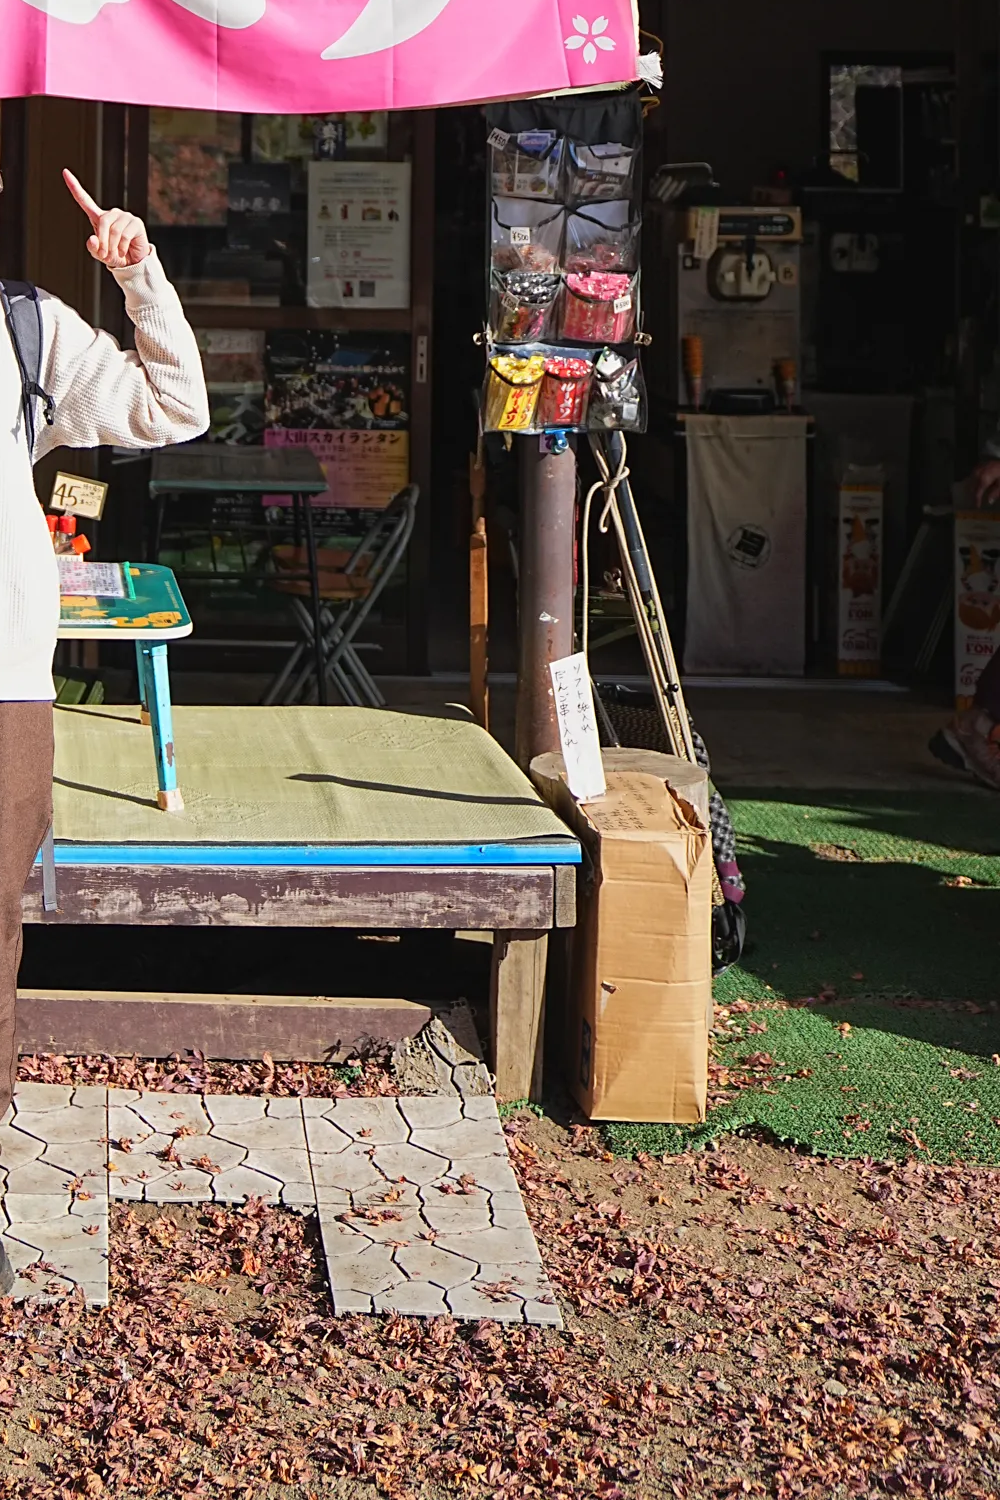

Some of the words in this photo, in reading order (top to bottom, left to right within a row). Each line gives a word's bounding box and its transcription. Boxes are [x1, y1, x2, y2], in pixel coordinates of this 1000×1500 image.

[283, 431, 401, 444] 大山スカイランタン
[54, 483, 81, 507] 45
